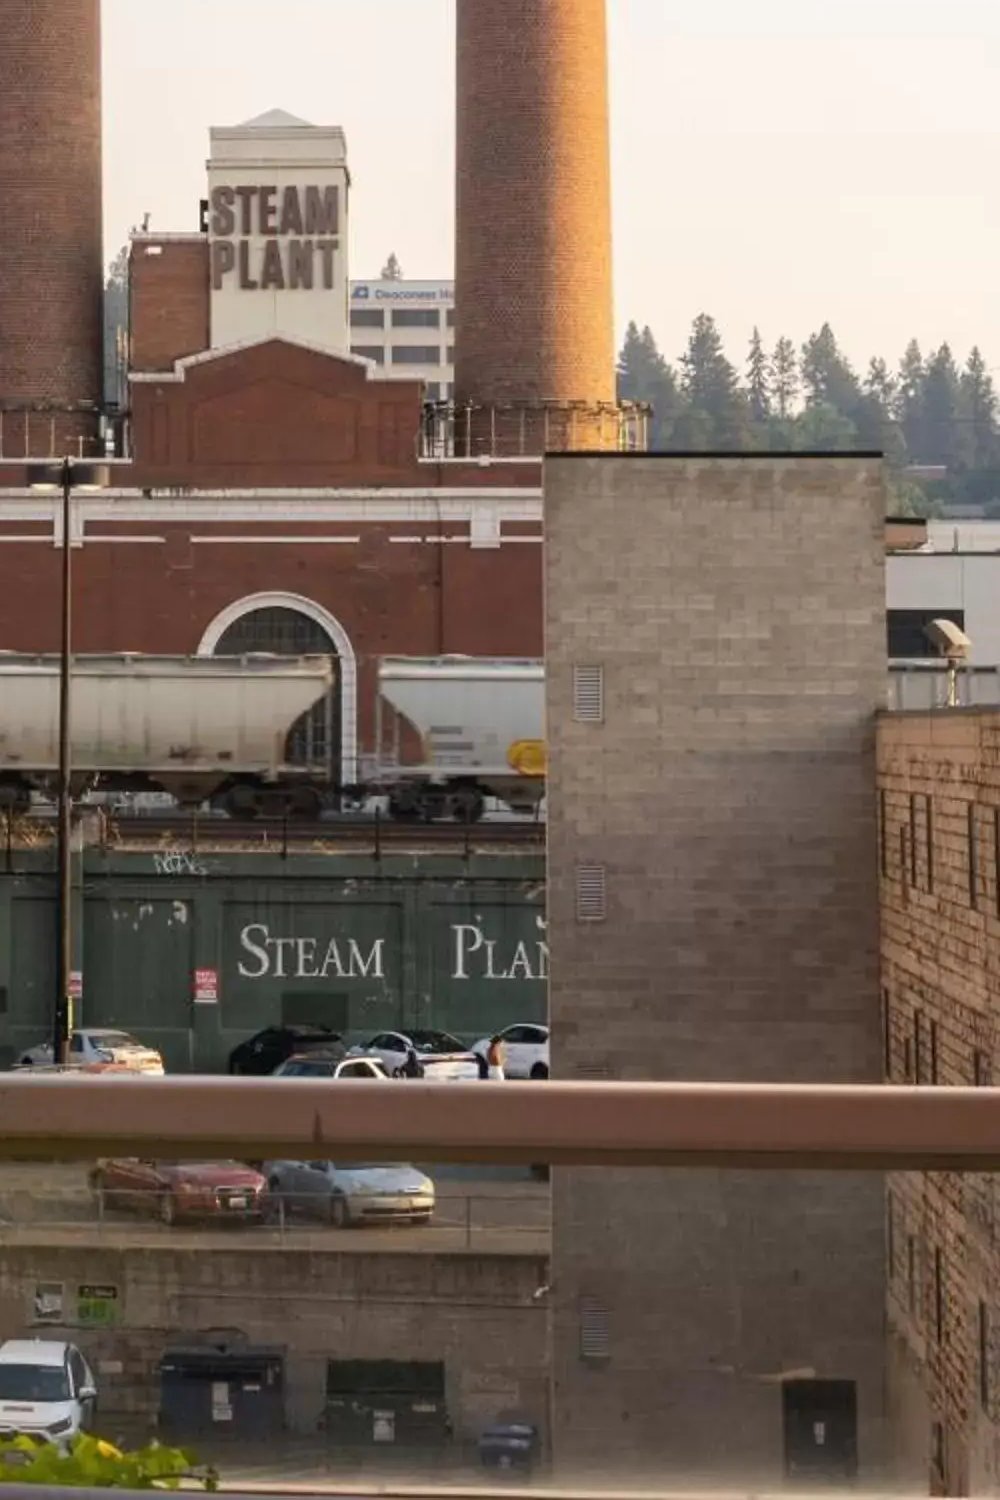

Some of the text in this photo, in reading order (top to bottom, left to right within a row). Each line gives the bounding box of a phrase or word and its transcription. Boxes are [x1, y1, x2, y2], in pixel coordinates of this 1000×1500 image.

[211, 185, 339, 236] STEAM
[212, 239, 339, 290] PLANT
[237, 924, 385, 977] STEAM
